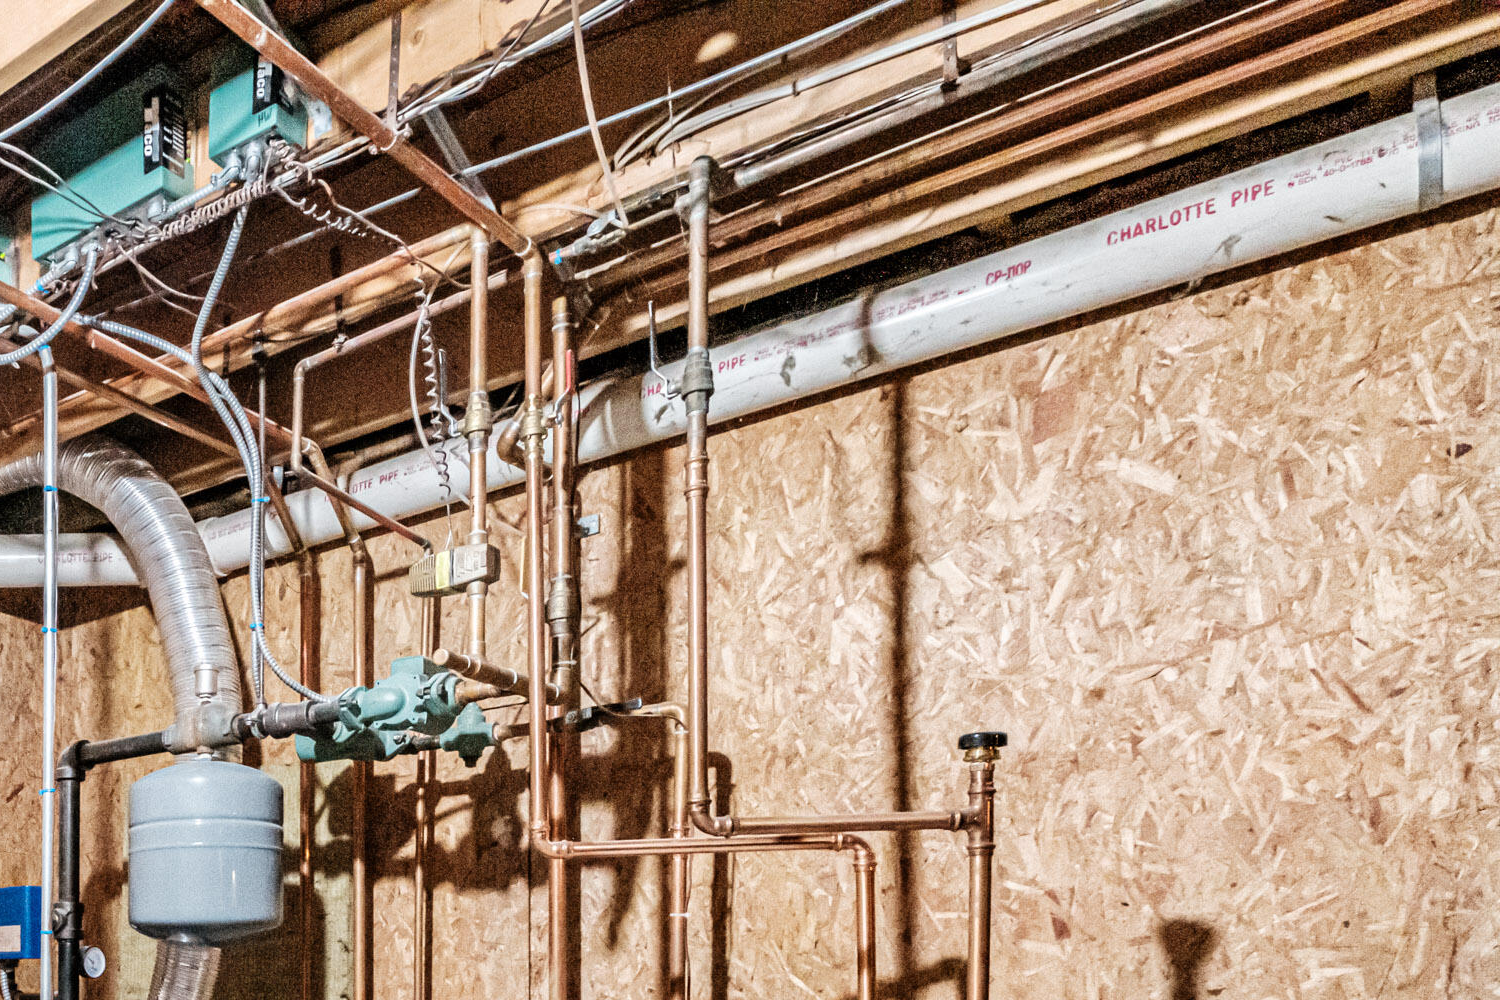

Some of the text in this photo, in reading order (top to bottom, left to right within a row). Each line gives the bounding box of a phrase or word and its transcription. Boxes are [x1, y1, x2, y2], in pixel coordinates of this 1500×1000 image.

[1106, 179, 1276, 246] CHARLOTTE PIPE
[718, 353, 747, 374] PIPE
